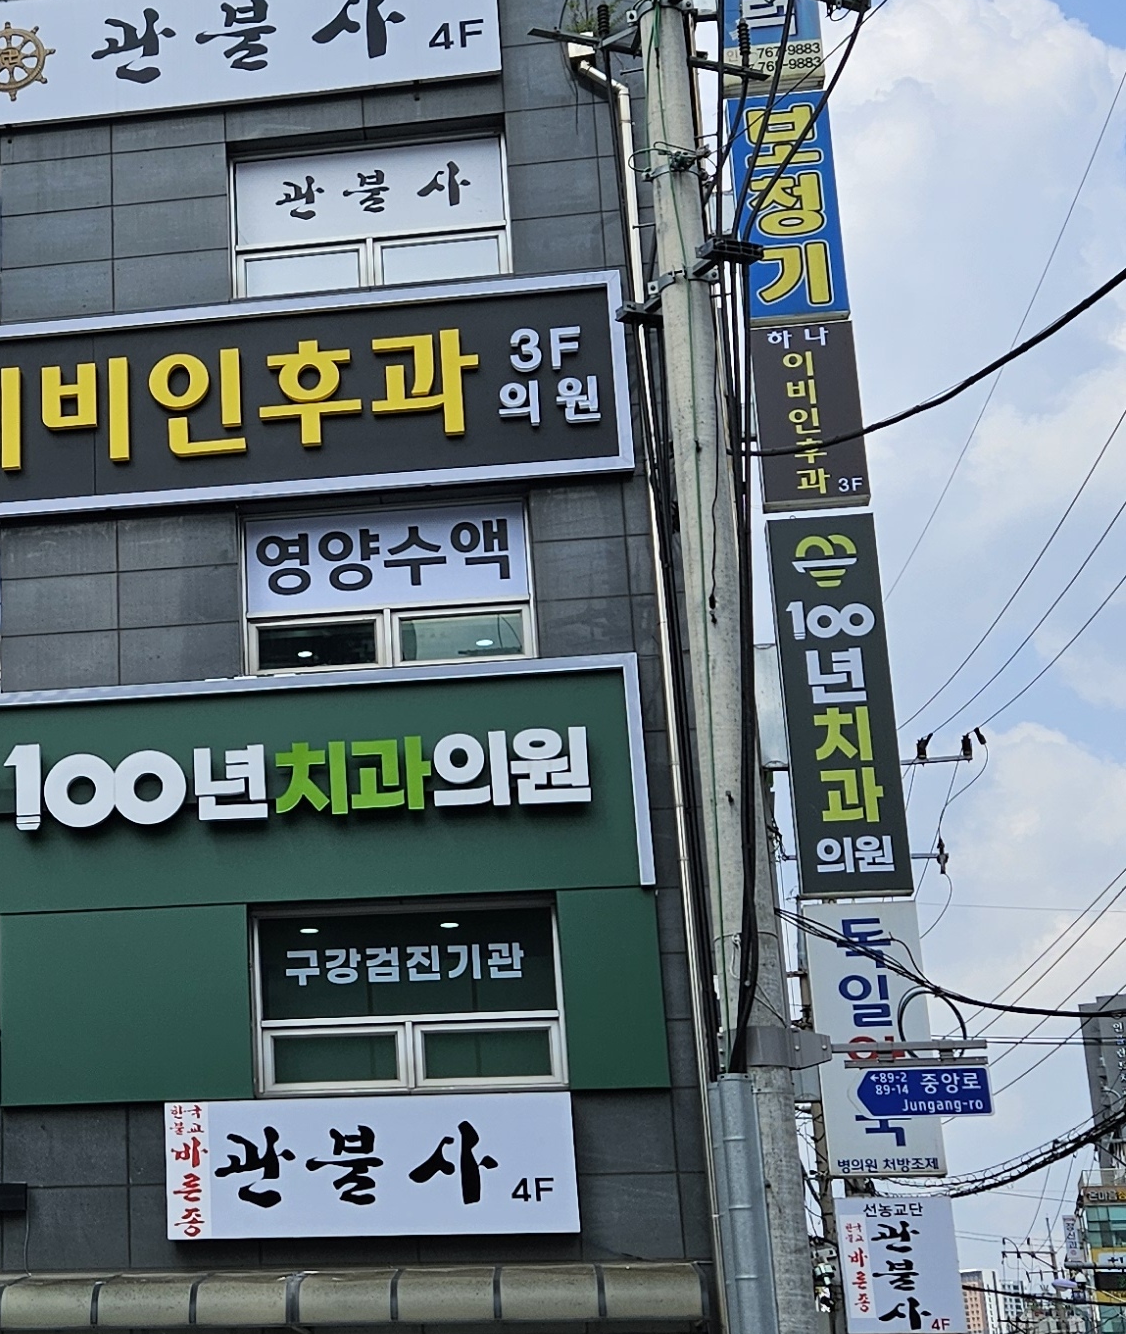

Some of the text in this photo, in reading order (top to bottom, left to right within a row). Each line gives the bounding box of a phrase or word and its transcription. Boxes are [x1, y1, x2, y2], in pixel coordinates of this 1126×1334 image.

[428, 18, 486, 51] 4F
[757, 43, 821, 59] 767-9883
[274, 161, 471, 221] 관불사
[745, 102, 834, 306] 보청기
[509, 326, 582, 374] 3F
[766, 326, 829, 349] 하나
[498, 375, 601, 427] 의원
[782, 351, 864, 495] 이비인후과 3F
[256, 518, 512, 597] 영양수액
[3, 725, 593, 832] 100년치과의원
[285, 941, 526, 987] 구강검진기관
[875, 1084, 910, 1096] 89-14
[879, 1071, 982, 1095] 89-2 중앙로
[902, 1098, 984, 1114] Jungang-ro
[170, 1136, 209, 1238] 바른종
[214, 1120, 556, 1209] 관불사 4F
[837, 1156, 940, 1174] 병의원 처방조제
[863, 1202, 924, 1218] 선농교단
[870, 1220, 951, 1331] 관불사 4F
